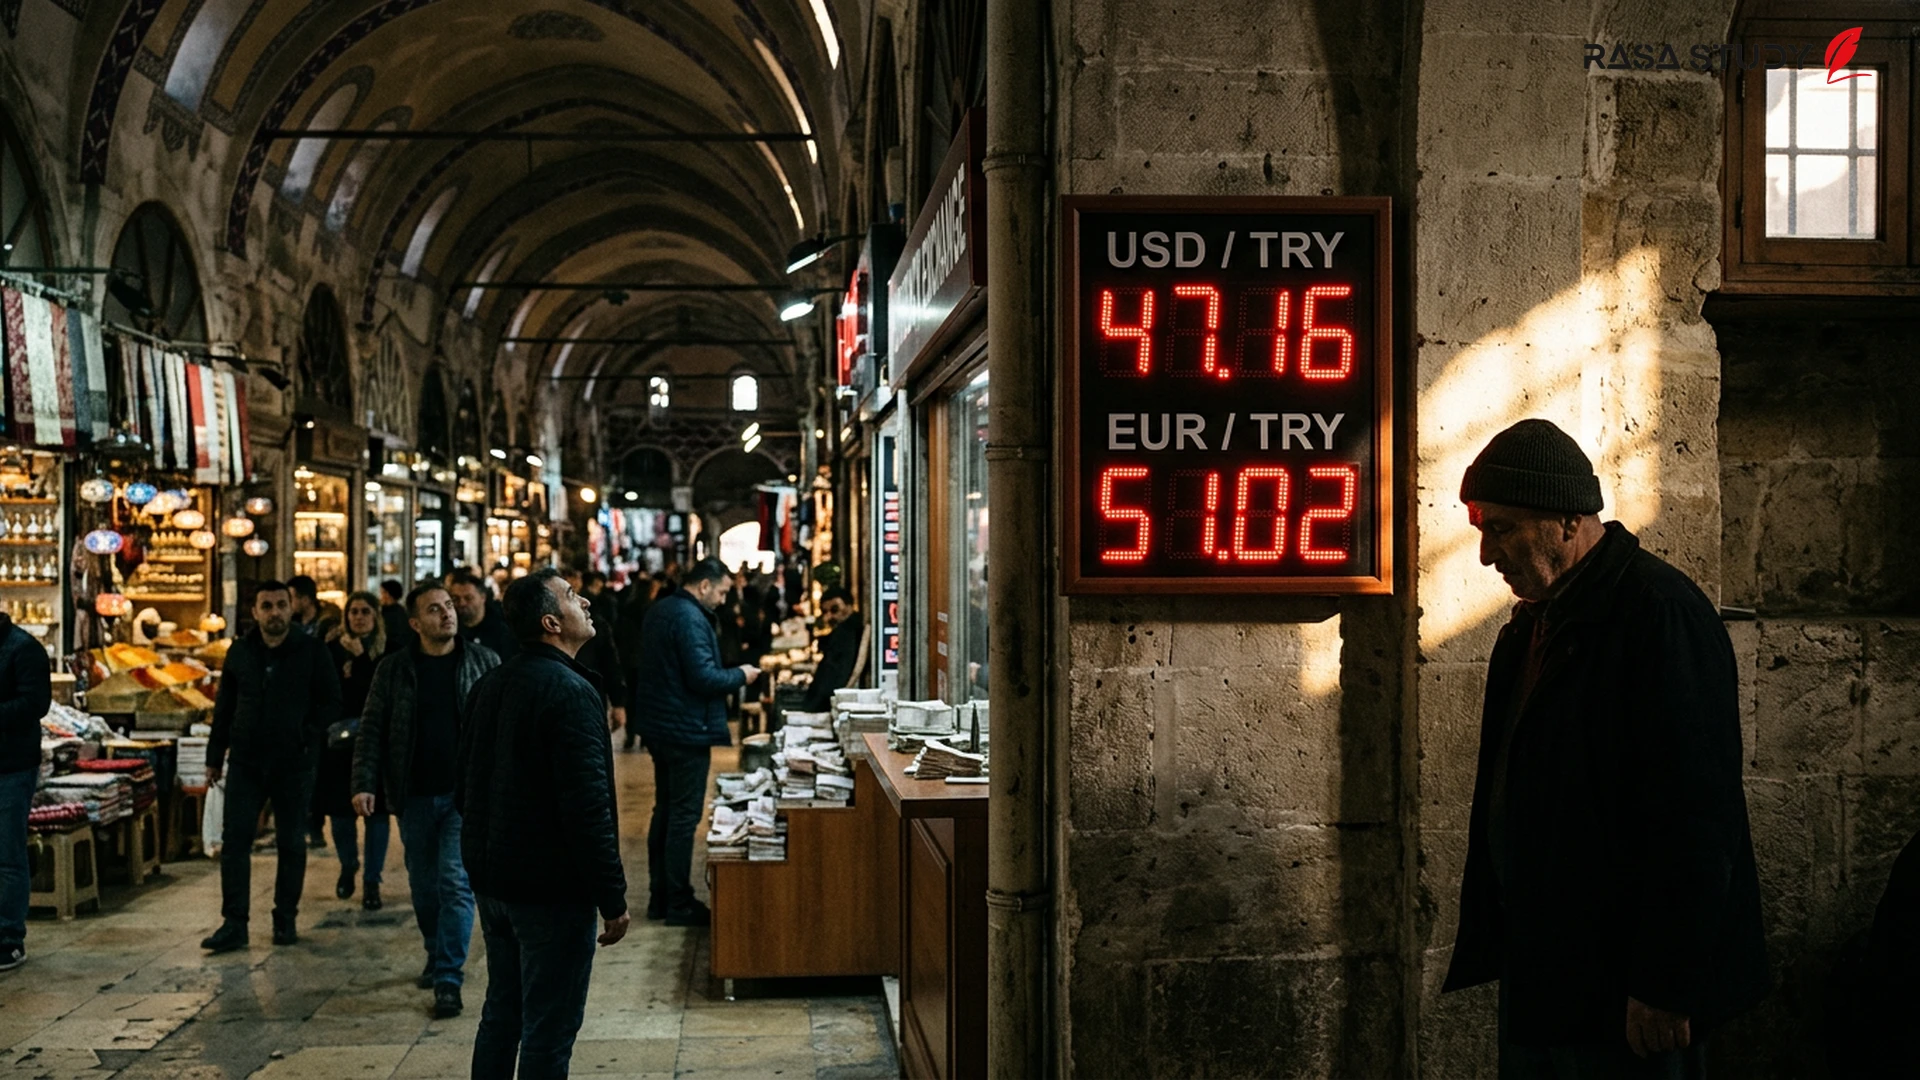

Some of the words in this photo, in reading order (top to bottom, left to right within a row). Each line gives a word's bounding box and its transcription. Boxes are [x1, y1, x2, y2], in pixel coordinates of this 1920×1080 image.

[1107, 231, 1206, 269] USD
[1221, 231, 1236, 269] /
[1249, 231, 1345, 269] TRY
[1100, 285, 1355, 380] 47.16
[1107, 412, 1208, 450] EUR
[1221, 412, 1236, 450] /
[1249, 412, 1345, 450] TRY
[1099, 465, 1356, 562] 51.02
